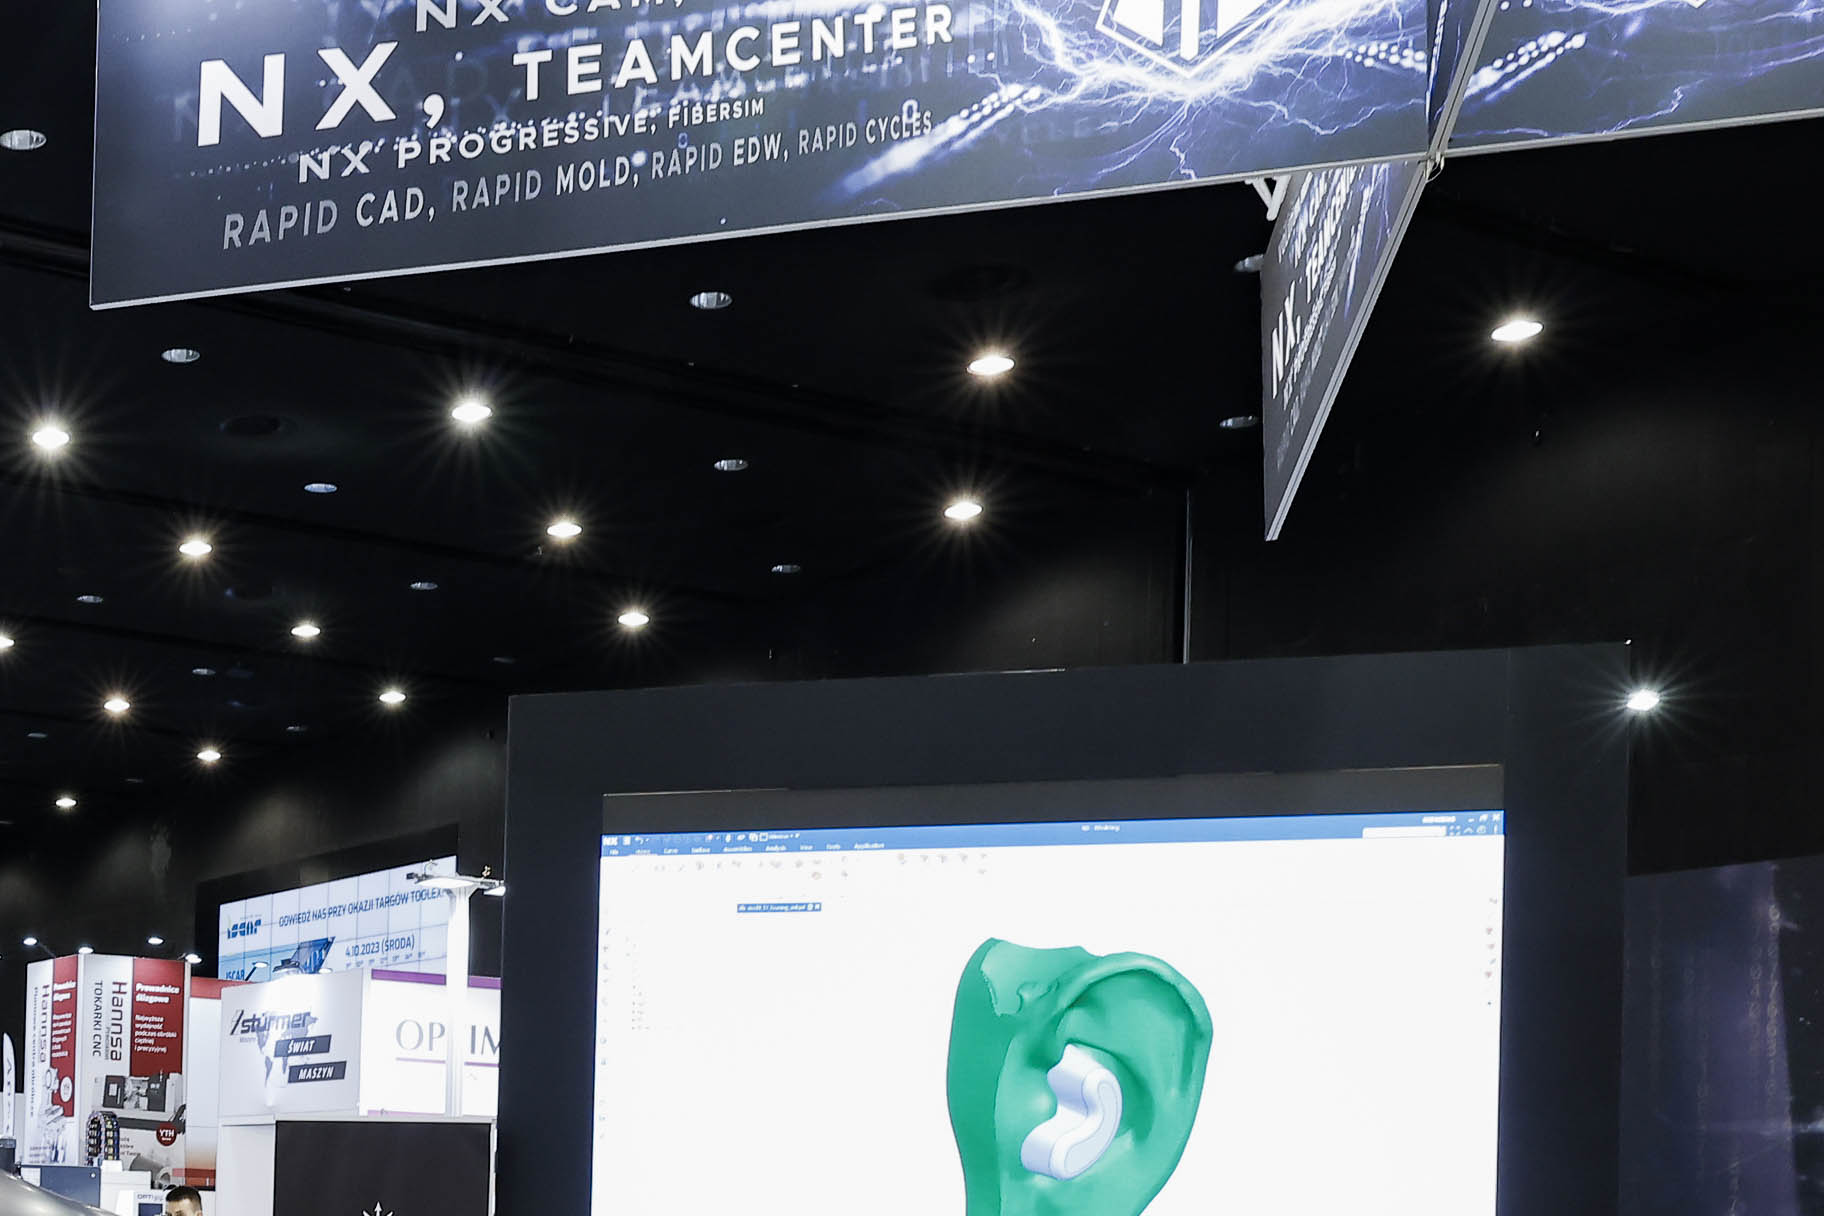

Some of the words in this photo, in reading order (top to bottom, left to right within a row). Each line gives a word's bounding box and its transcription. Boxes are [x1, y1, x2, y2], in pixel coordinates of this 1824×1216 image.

[197, 41, 445, 147] NX,
[513, 4, 953, 101] TEAMCENTER
[298, 147, 371, 184] NX
[398, 113, 658, 169] PROGRESSIVE,
[668, 98, 765, 130] FIBERSIM
[223, 200, 338, 250] RAPID
[356, 187, 436, 227] CAD,
[452, 169, 542, 213] RAPID
[556, 159, 639, 196] MOLD,
[651, 143, 722, 181] RAPID
[733, 134, 789, 167] EDW,
[798, 122, 857, 156] RAPID
[865, 110, 933, 144] CYCLES
[312, 903, 327, 921] NAS
[328, 899, 347, 918] PRZY
[348, 896, 374, 914] OKAZJI
[93, 980, 103, 1032] TOKARKI
[110, 981, 128, 1062] Hannsa
[92, 1033, 102, 1057] CNC
[288, 1039, 316, 1055] ŚWIAT
[298, 1065, 334, 1081] MASZYN
